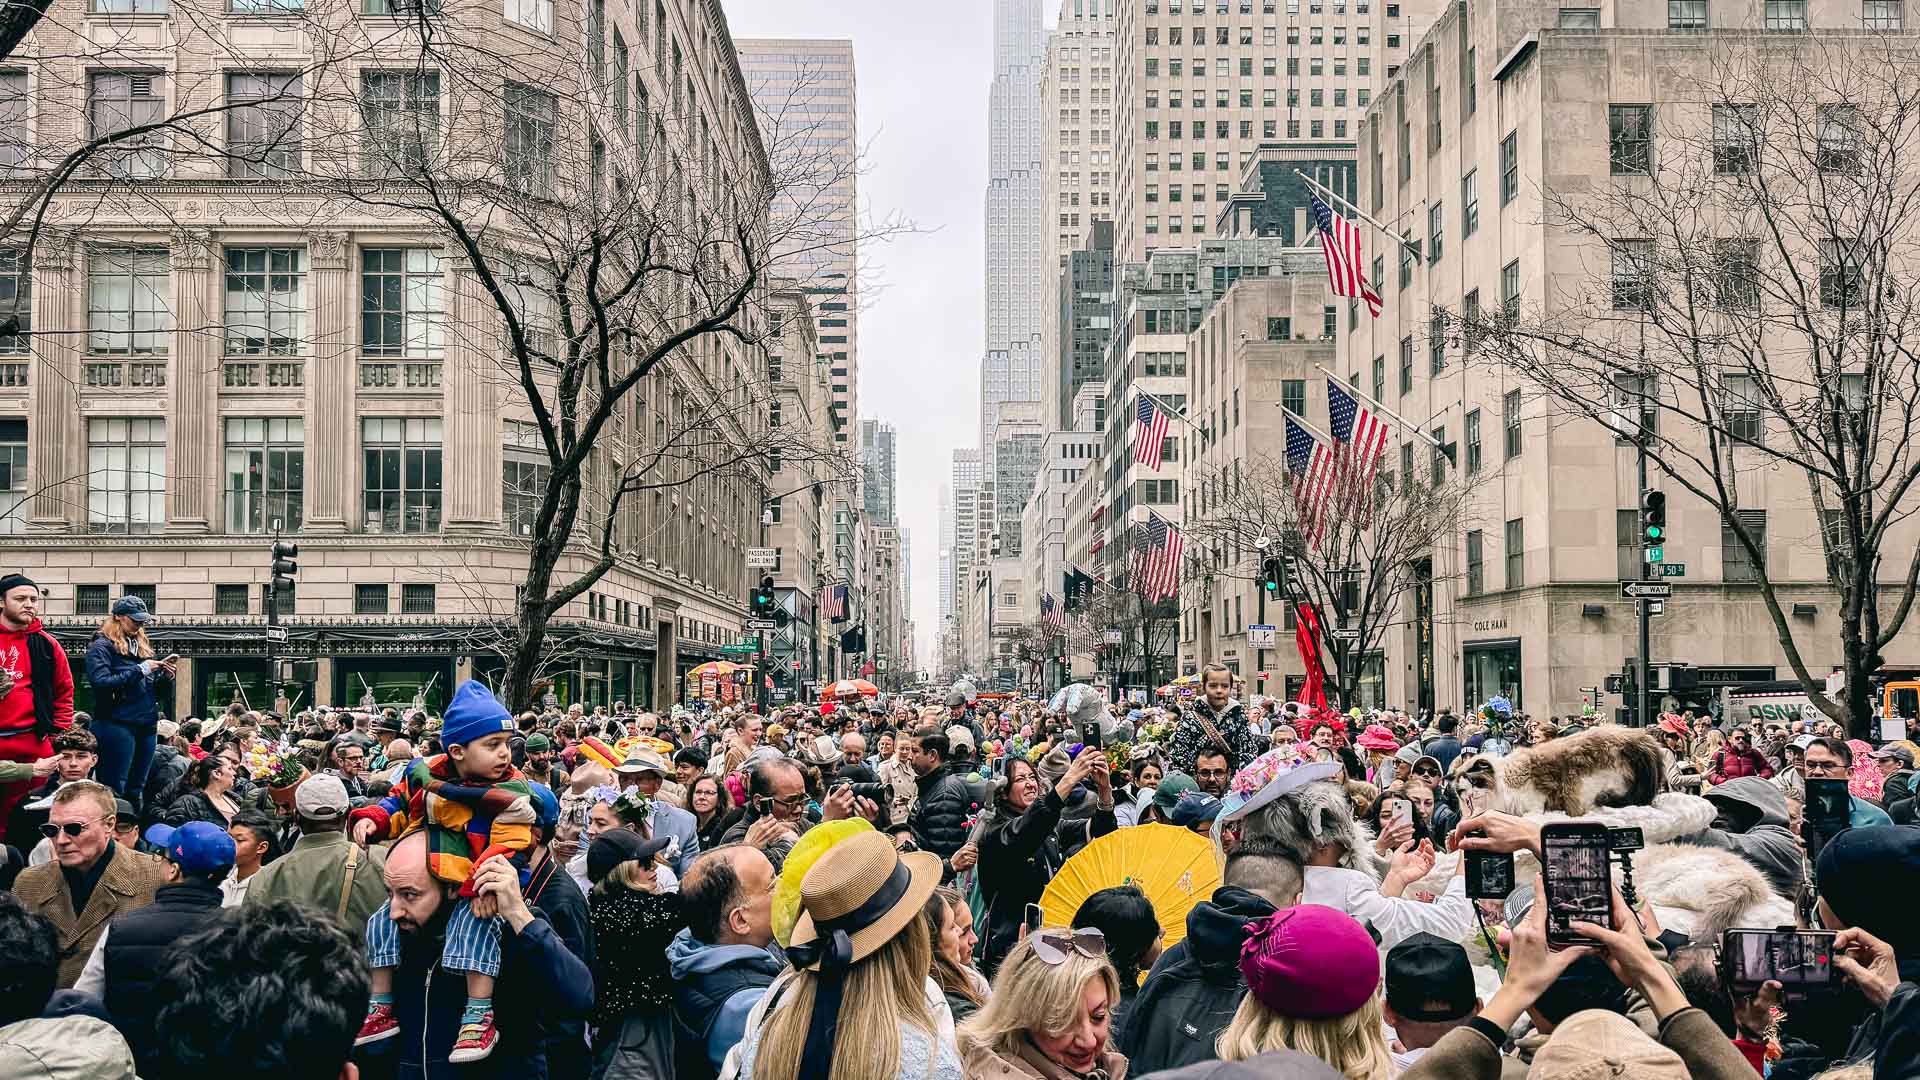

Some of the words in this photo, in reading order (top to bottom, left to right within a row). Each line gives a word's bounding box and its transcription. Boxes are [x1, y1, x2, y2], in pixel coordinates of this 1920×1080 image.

[1658, 565, 1665, 575] W
[1667, 565, 1677, 575] 50
[1474, 621, 1489, 631] COLE
[1491, 619, 1507, 630] HAAN
[1703, 671, 1739, 681] HAAN
